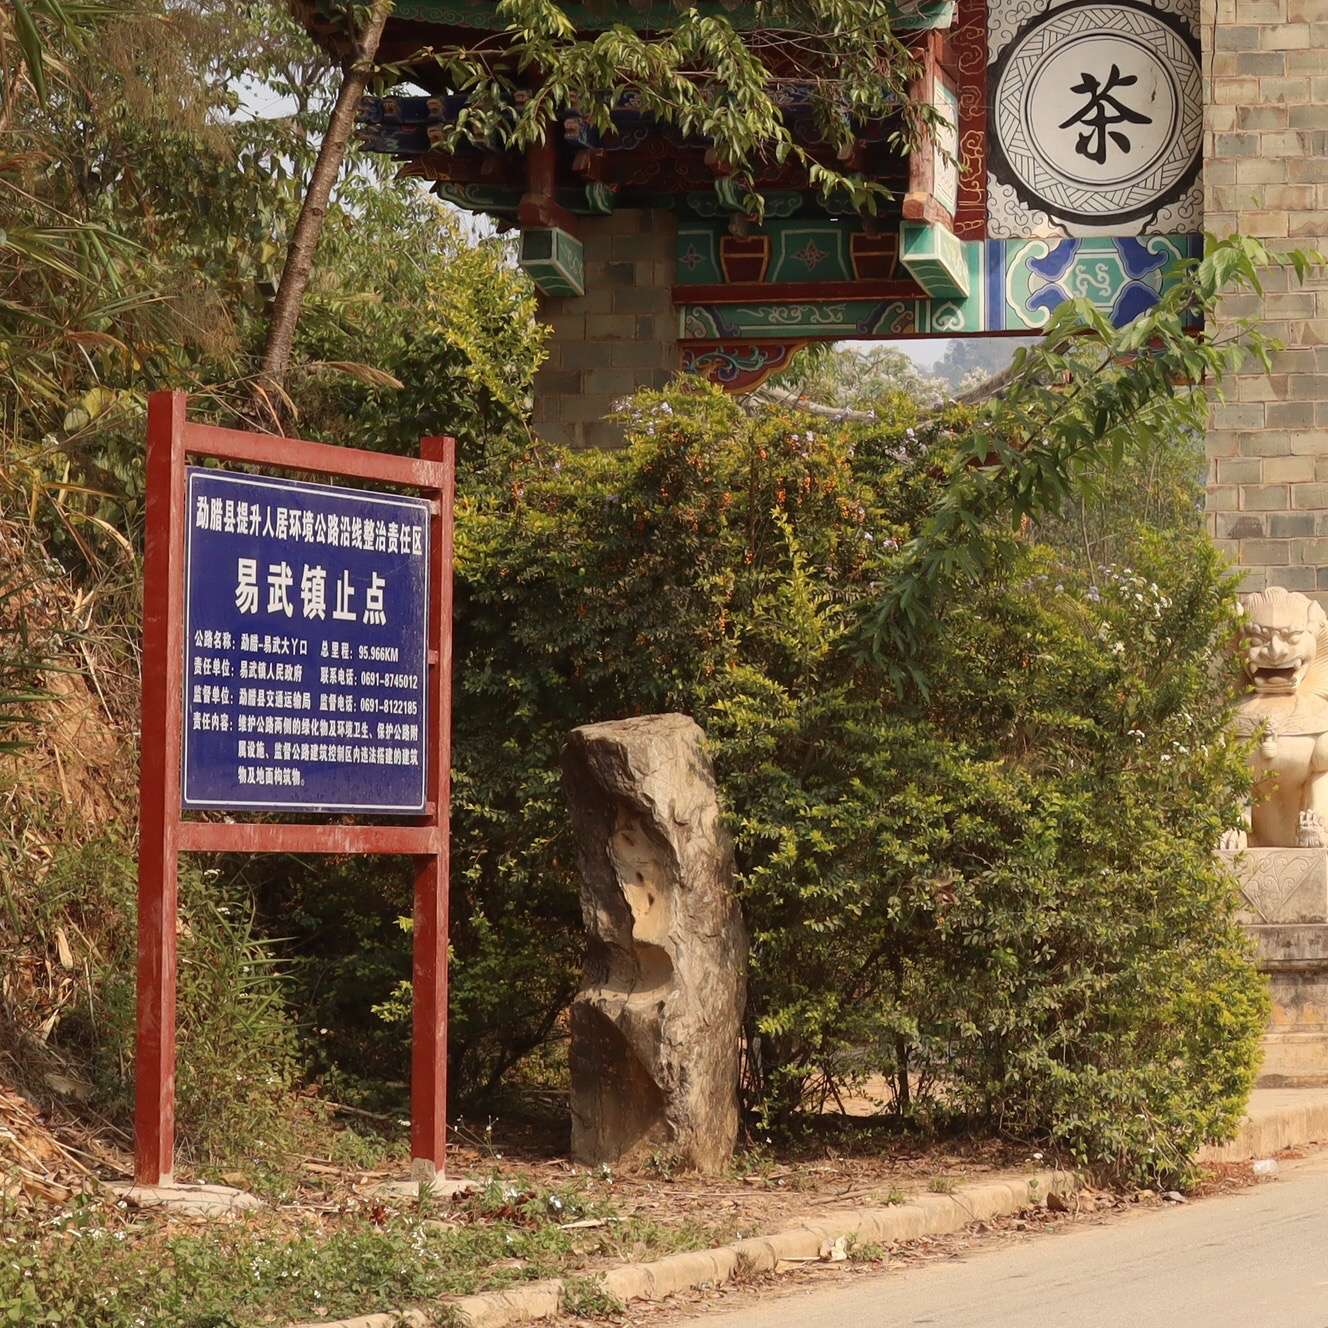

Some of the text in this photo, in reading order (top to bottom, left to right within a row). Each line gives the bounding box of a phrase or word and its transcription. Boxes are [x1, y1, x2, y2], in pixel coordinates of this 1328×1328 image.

[1058, 63, 1153, 165] 茶
[196, 496, 423, 555] 勐腊县提升人居环境公路沿线整治责任区
[235, 558, 387, 625] 易武镇止点
[239, 660, 303, 683] 易武镇人民政府
[361, 671, 418, 689] 0691-8745012
[358, 645, 399, 662] 95.966KM
[238, 687, 311, 710] 勐腊县交通运输局
[360, 697, 418, 715] 0691-8122185
